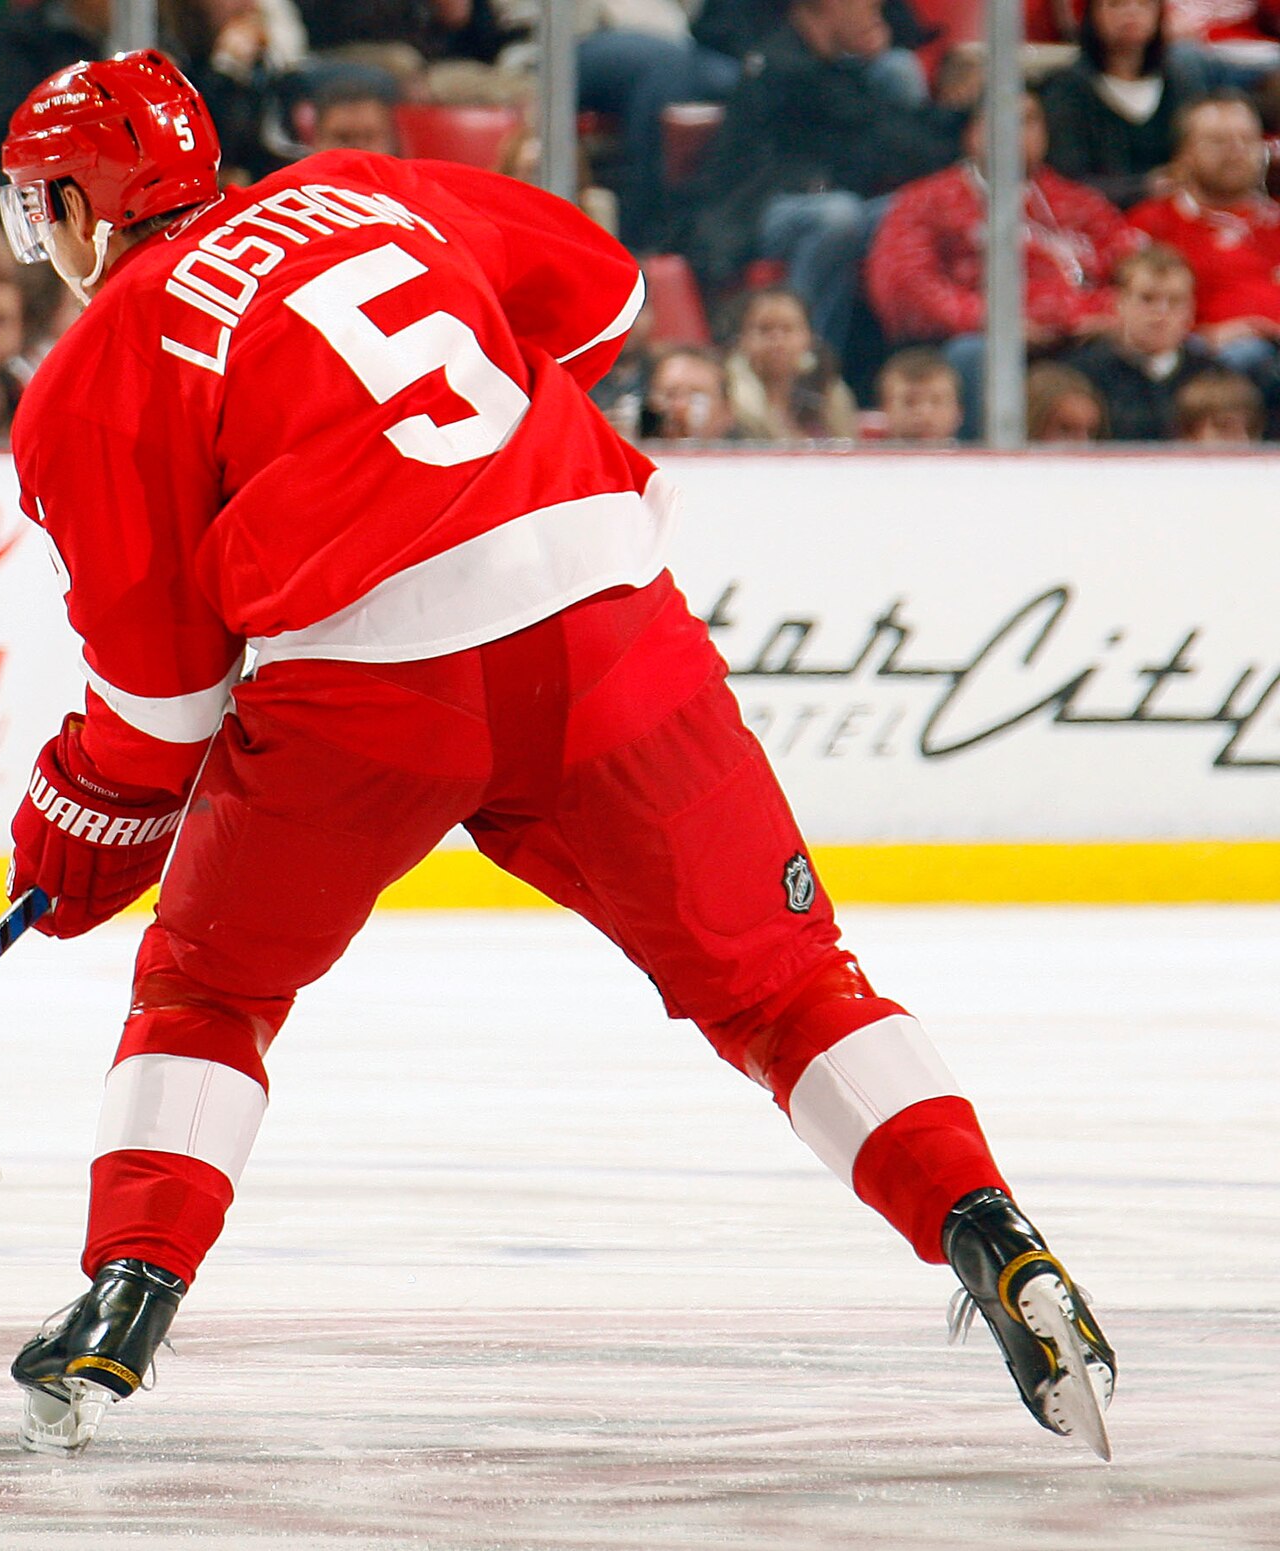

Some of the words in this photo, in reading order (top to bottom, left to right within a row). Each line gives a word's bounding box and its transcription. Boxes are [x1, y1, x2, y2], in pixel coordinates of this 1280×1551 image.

[173, 113, 195, 151] 5
[161, 184, 447, 376] LIDSTROM
[283, 242, 531, 466] 5
[29, 766, 186, 846] WARRIO
